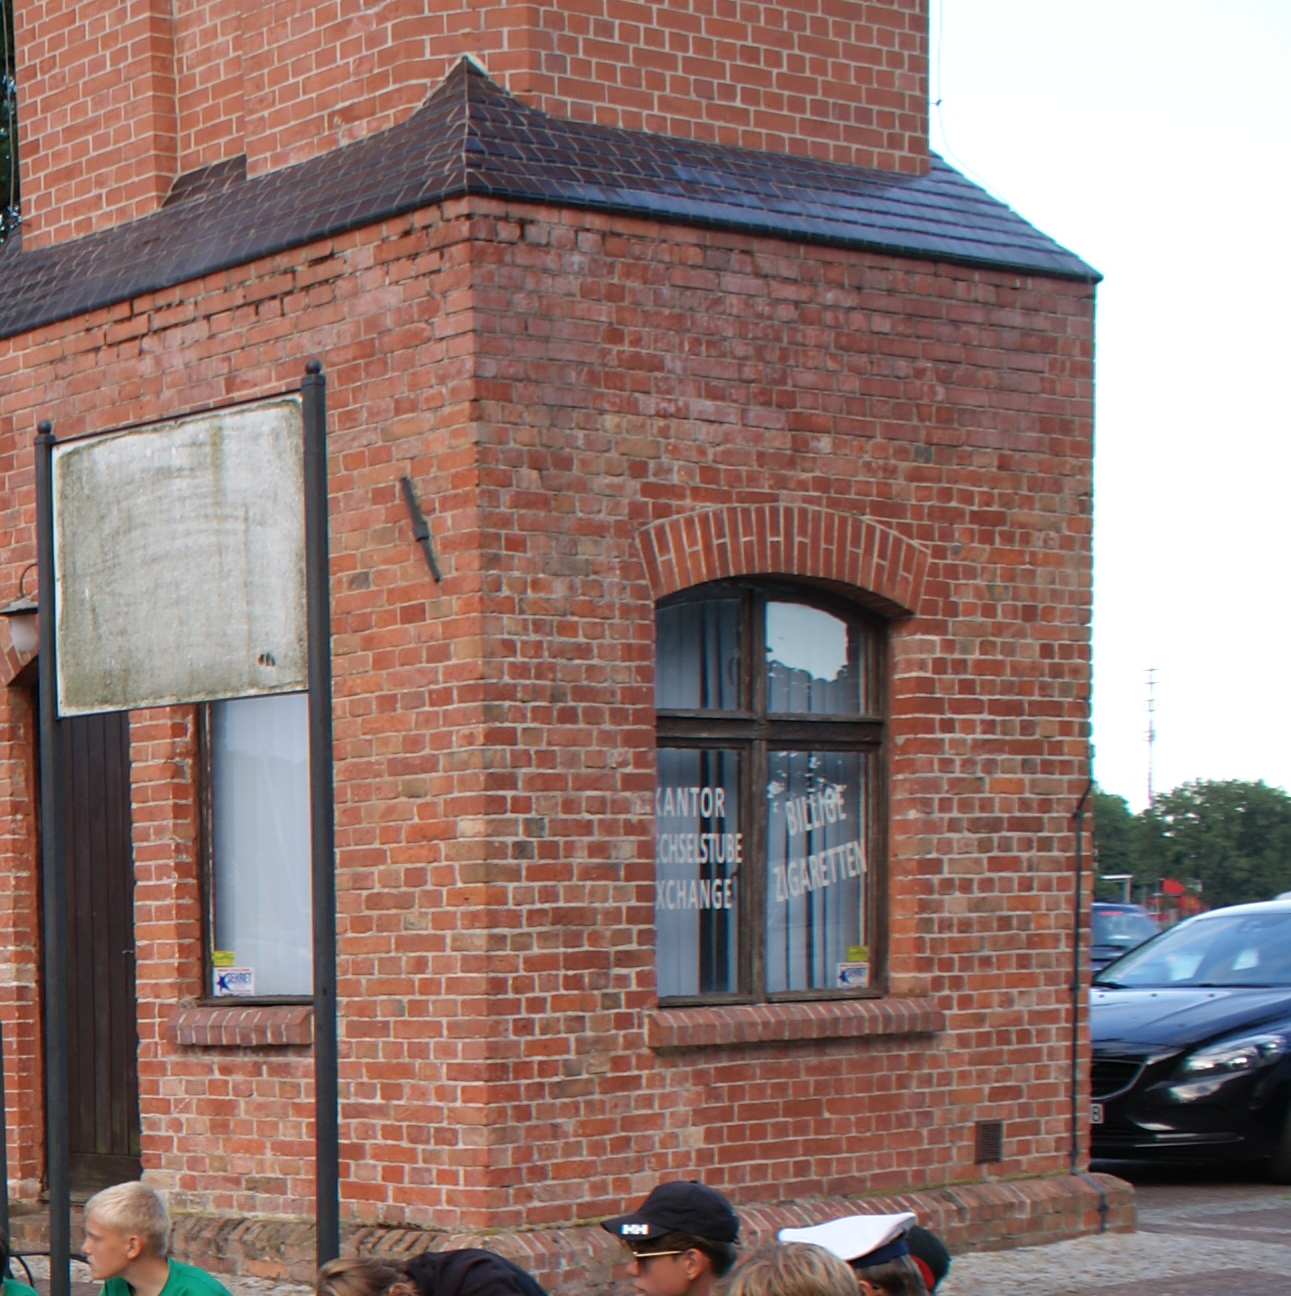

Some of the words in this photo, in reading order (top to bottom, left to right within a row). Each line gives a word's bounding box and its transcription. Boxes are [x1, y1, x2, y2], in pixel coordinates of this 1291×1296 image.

[656, 833, 743, 864] CHSELSTUBE
[772, 840, 868, 903] ZIGARETTEN
[655, 879, 733, 910] XCHANGE
